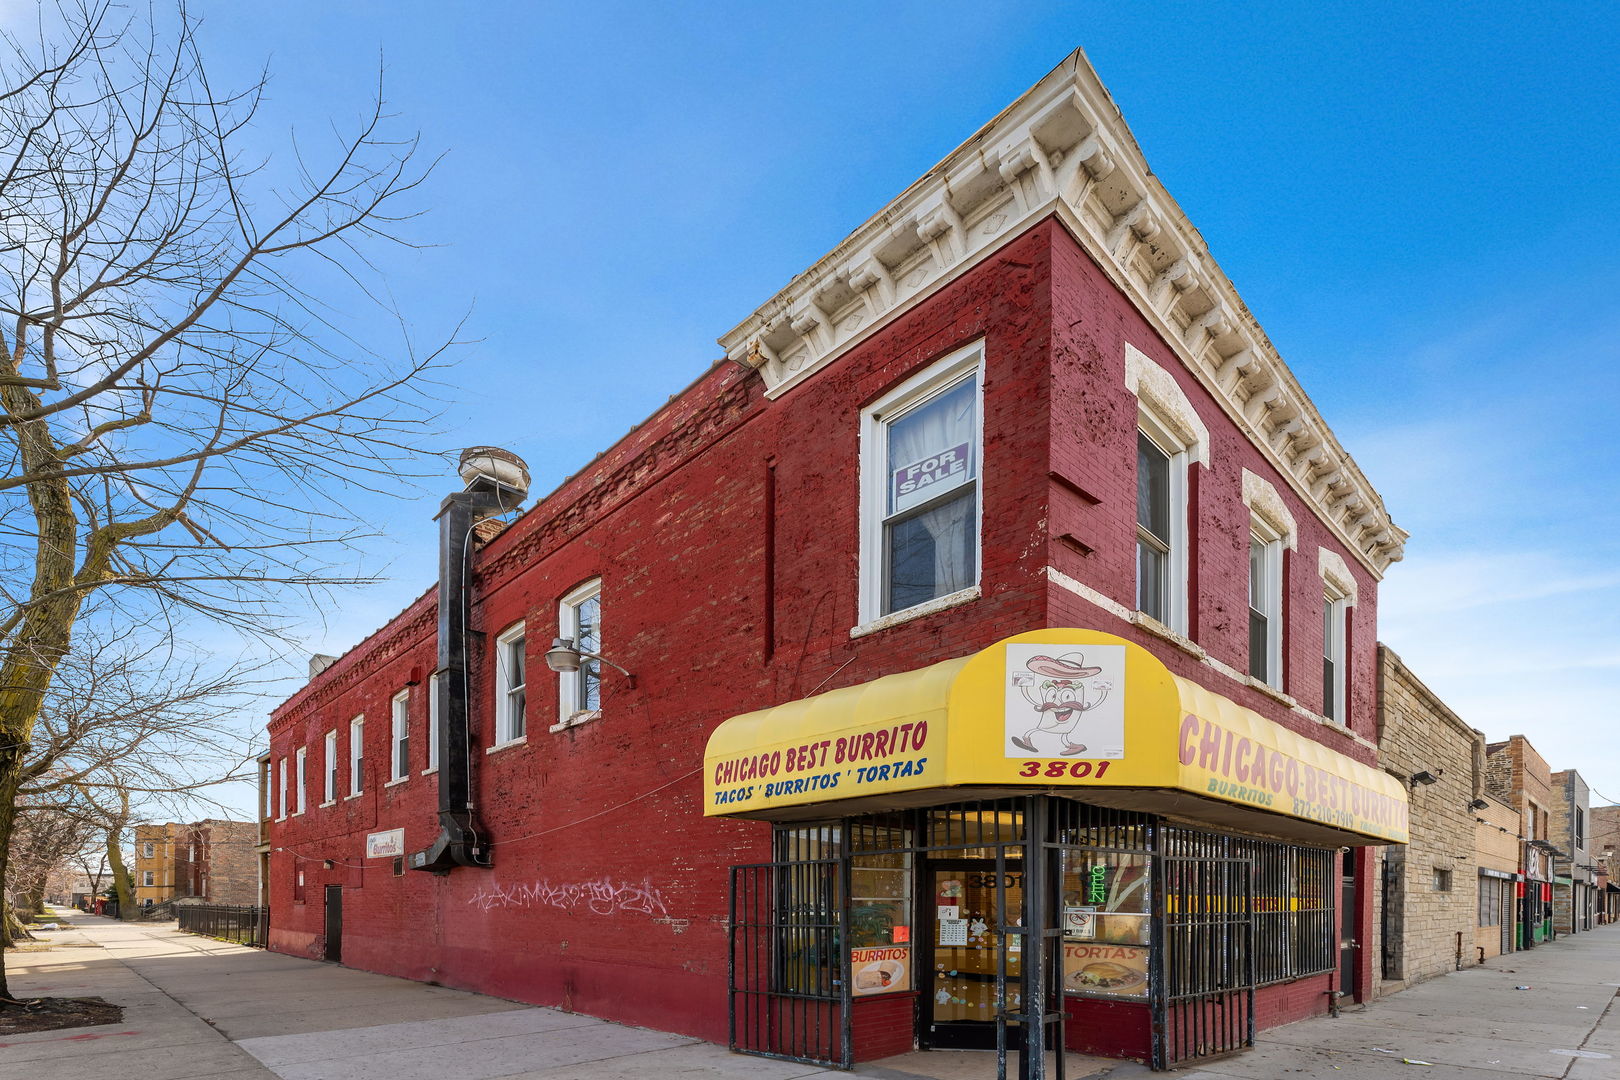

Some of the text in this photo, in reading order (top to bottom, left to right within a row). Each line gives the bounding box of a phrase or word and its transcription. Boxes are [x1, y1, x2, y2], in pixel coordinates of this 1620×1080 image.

[899, 458, 965, 494] SALE
[907, 450, 956, 480] FOR
[715, 720, 928, 786] CHICAGO BEST BURRITO
[1019, 760, 1111, 779] 3801
[714, 757, 928, 805] TACOS BURRITOS TORTAS
[1179, 714, 1408, 831] CHICAGO BEST BURRITO
[1207, 777, 1273, 807] BURRITOS
[1088, 865, 1106, 903] OPEN
[851, 947, 908, 964] BURRITOS
[1064, 945, 1139, 960] TORTAS
